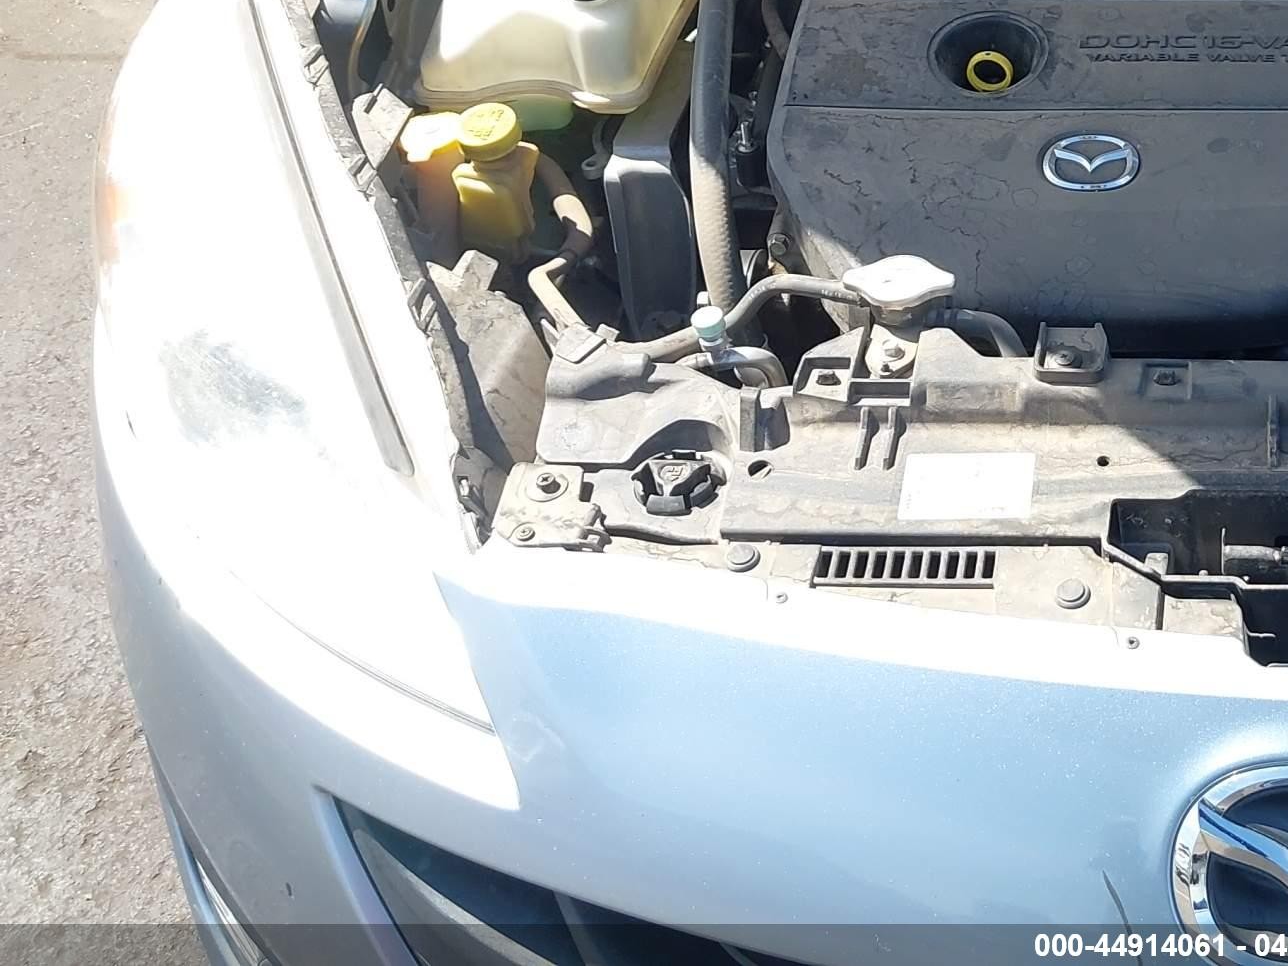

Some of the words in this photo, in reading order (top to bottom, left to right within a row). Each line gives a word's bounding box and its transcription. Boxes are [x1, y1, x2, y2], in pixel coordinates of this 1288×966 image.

[1080, 34, 1197, 49] DOHC
[1086, 53, 1201, 63] VARIABLE
[1206, 53, 1275, 63] VALVE
